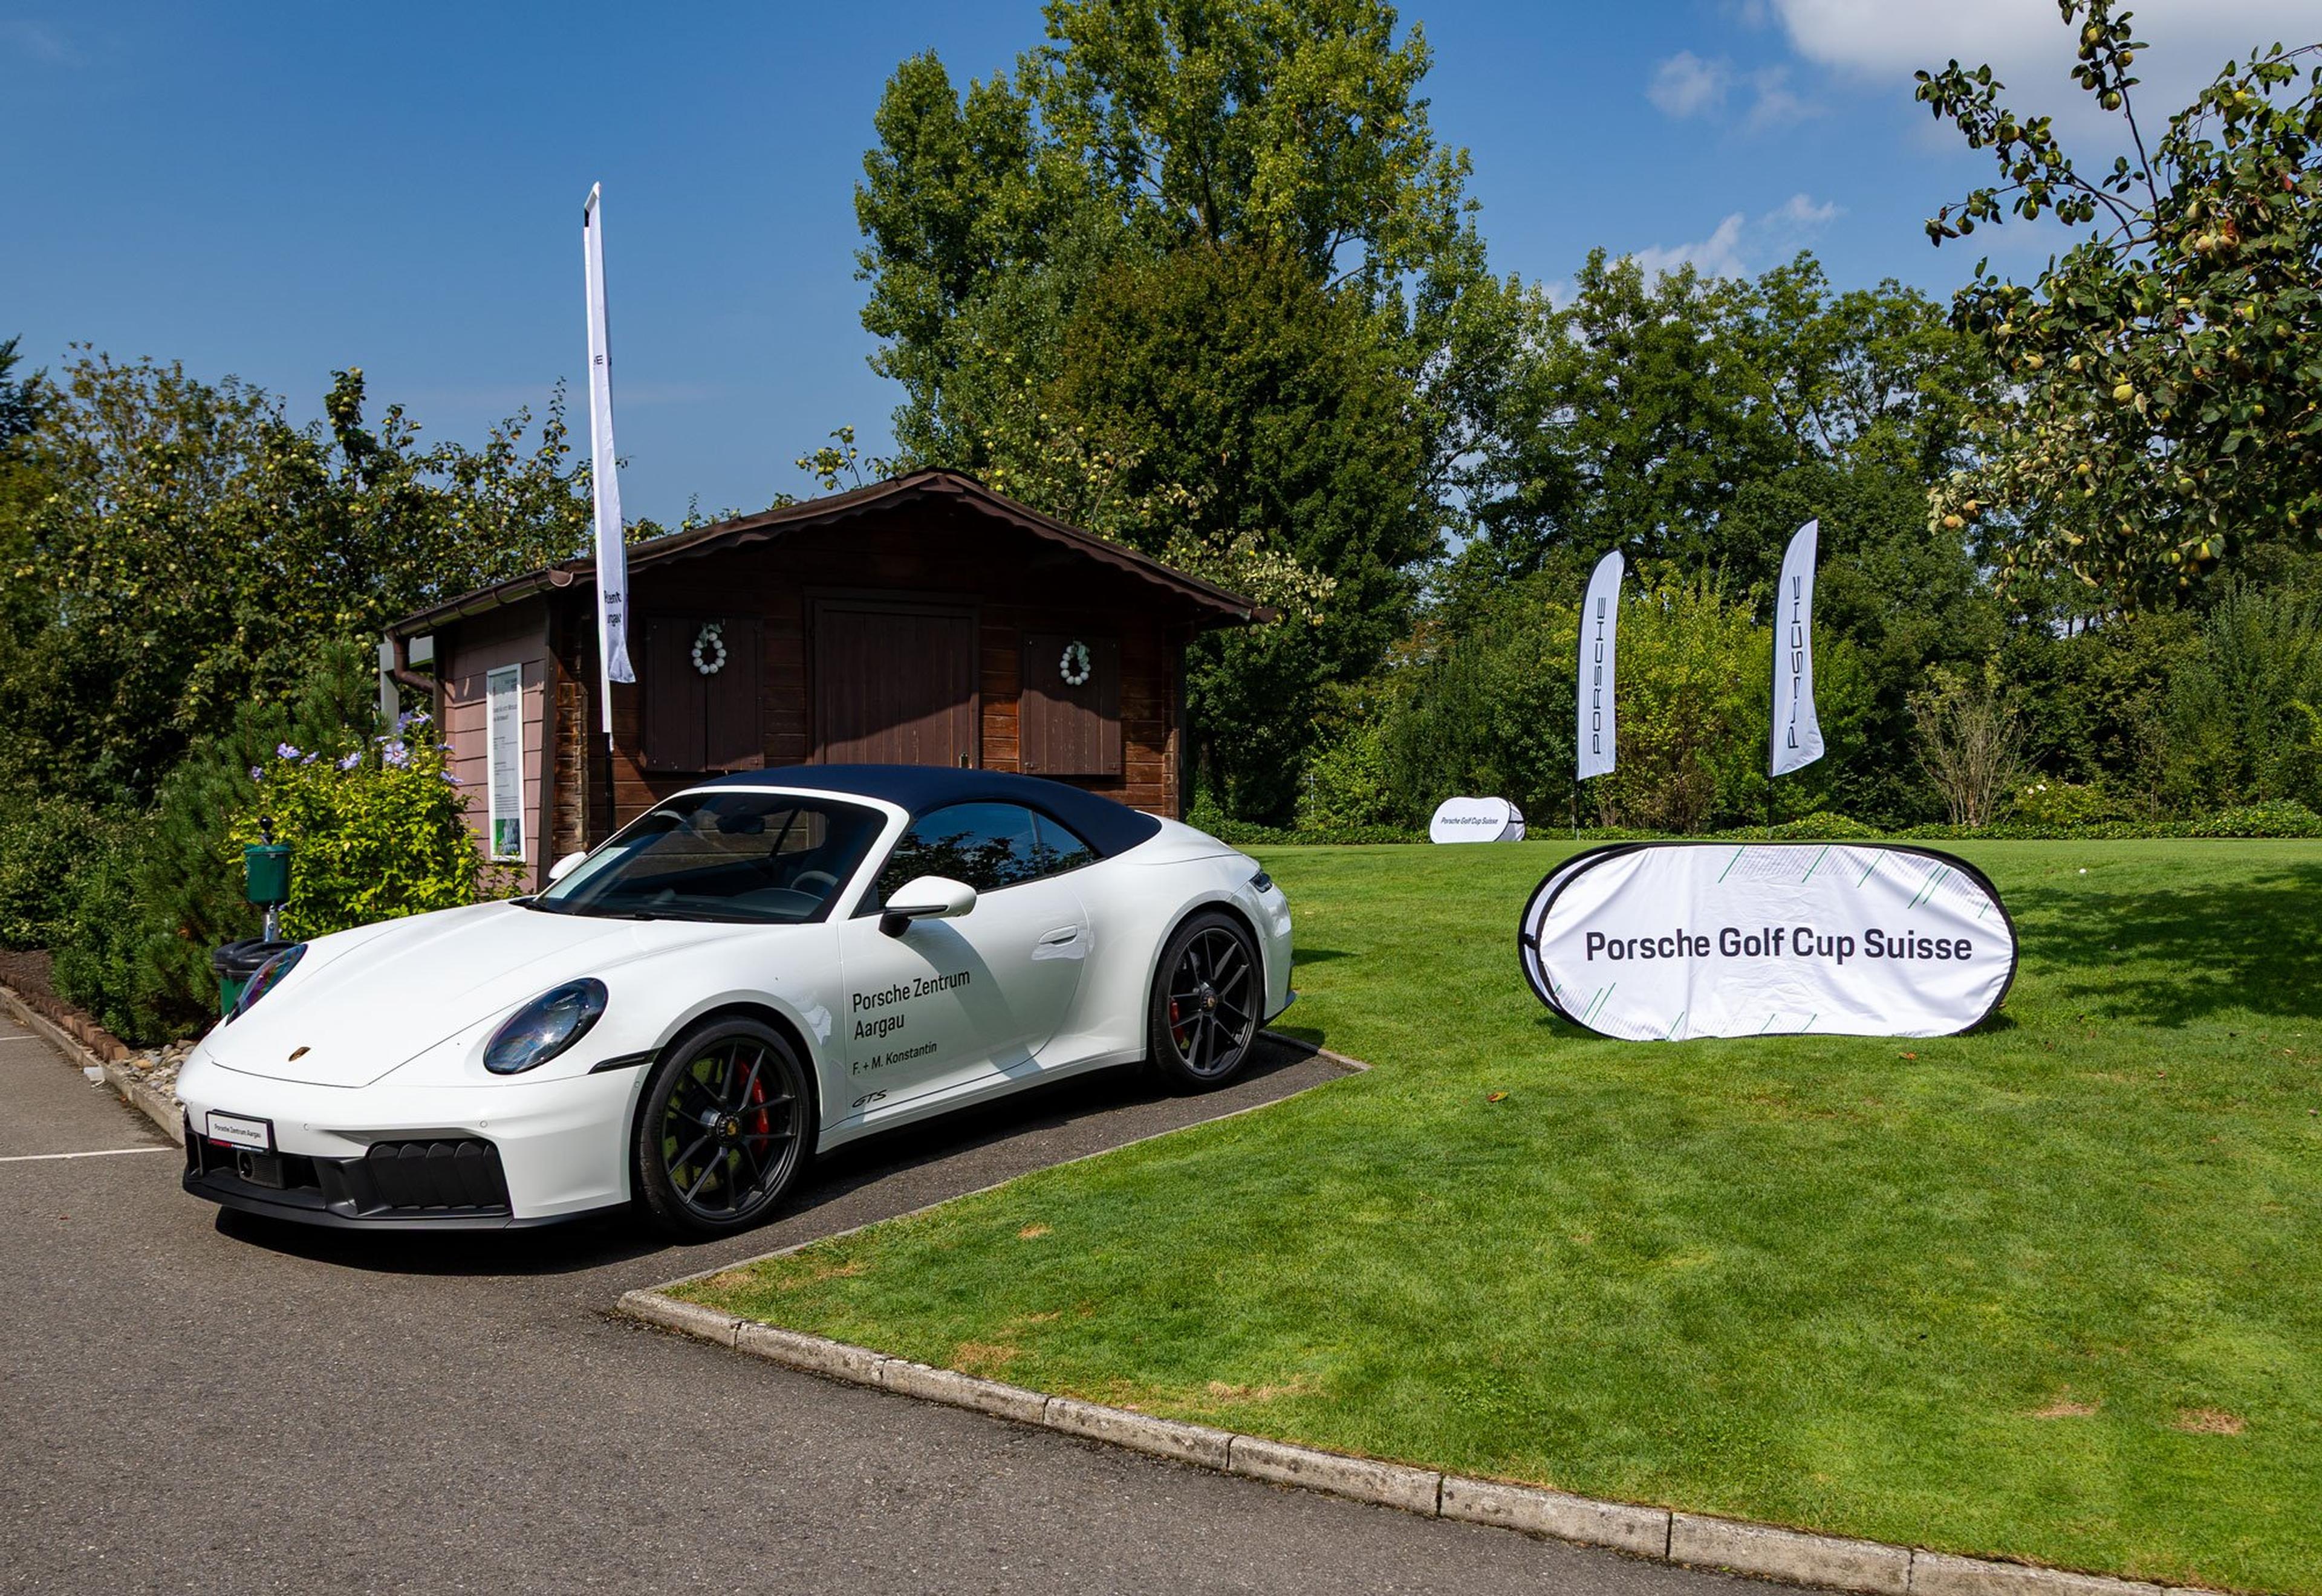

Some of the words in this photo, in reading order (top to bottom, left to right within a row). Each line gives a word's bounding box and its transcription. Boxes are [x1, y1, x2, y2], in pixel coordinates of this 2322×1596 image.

[1593, 597, 1607, 755] PORSCHE
[1472, 817, 1481, 826] Cup
[1585, 929, 1711, 961] Porsche
[1719, 927, 1785, 957] Golf
[1792, 927, 1855, 965] Cup
[1864, 929, 1972, 960] Suisse
[852, 984, 910, 1013] Porsche
[913, 971, 971, 997] Zentrum
[854, 1014, 905, 1040] Aargau
[852, 1061, 860, 1075] F.
[863, 1062, 870, 1071] +
[871, 1055, 883, 1070] M.
[886, 1041, 938, 1066] Konstantin
[851, 1089, 888, 1108] GTS
